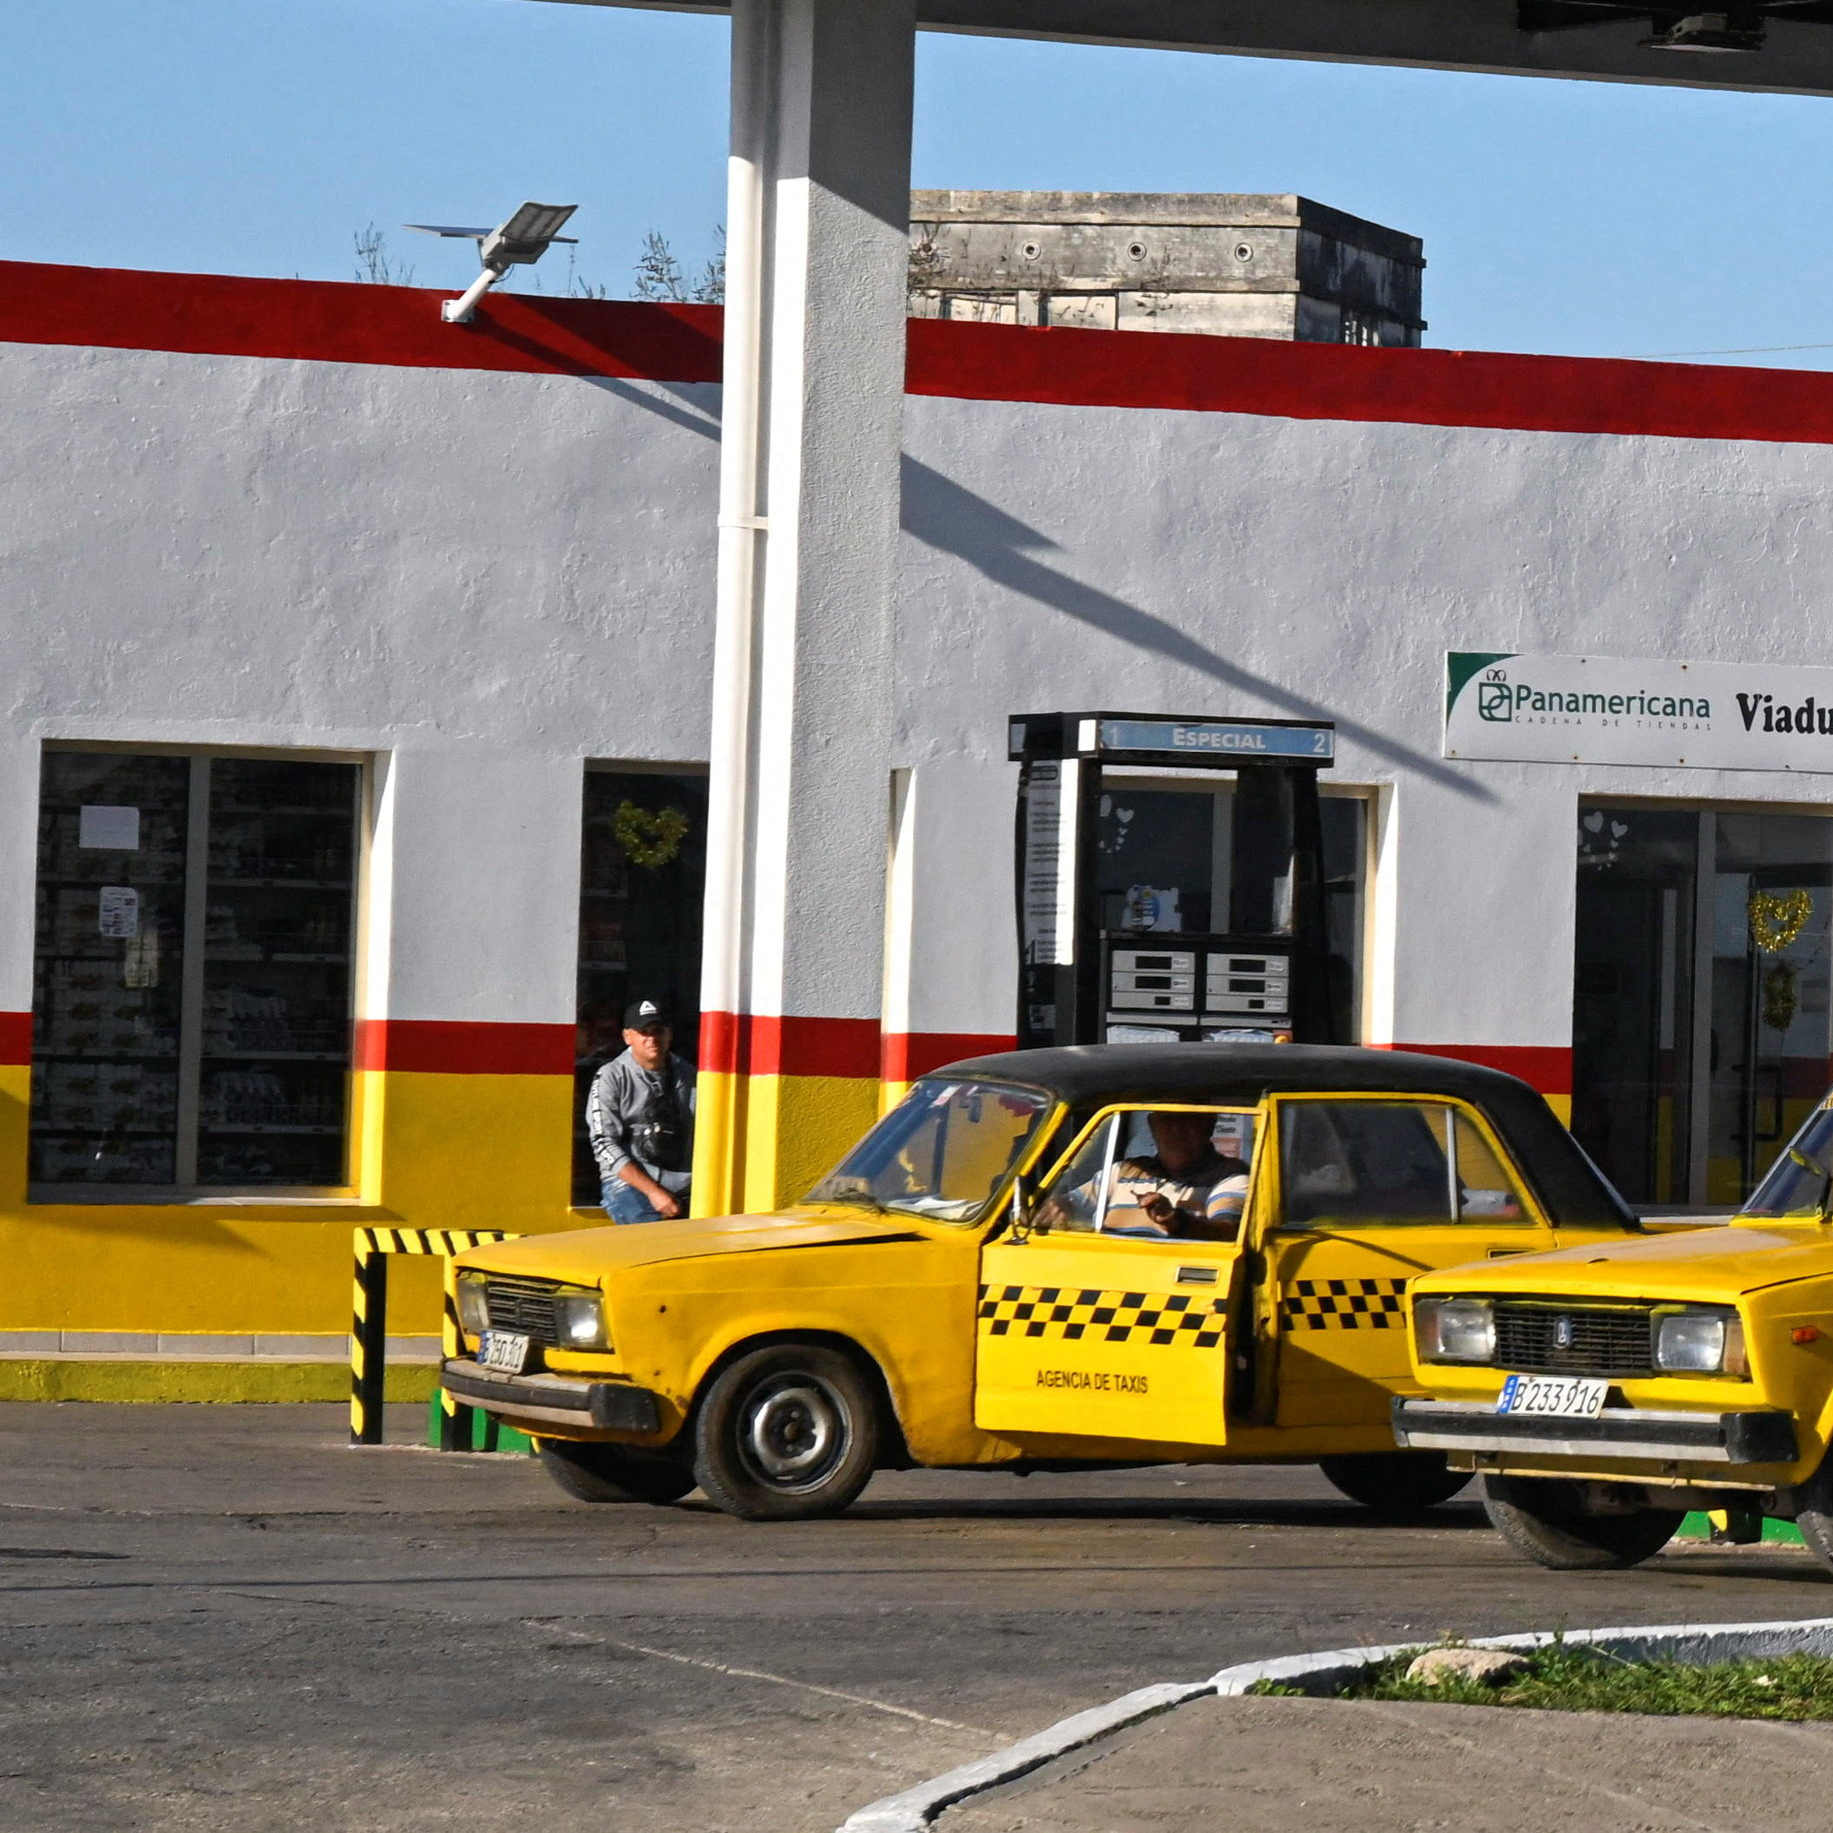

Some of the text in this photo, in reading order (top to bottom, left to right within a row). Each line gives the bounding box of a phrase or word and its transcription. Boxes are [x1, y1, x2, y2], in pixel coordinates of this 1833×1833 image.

[1515, 683, 1711, 719] Panamericana
[1515, 716, 1711, 731] CADENA DE TIENDAS
[1172, 728, 1266, 750] ESPECIAL
[1313, 733, 1326, 754] 2
[1036, 1370, 1149, 1394] AGENCIA DE TAXIS
